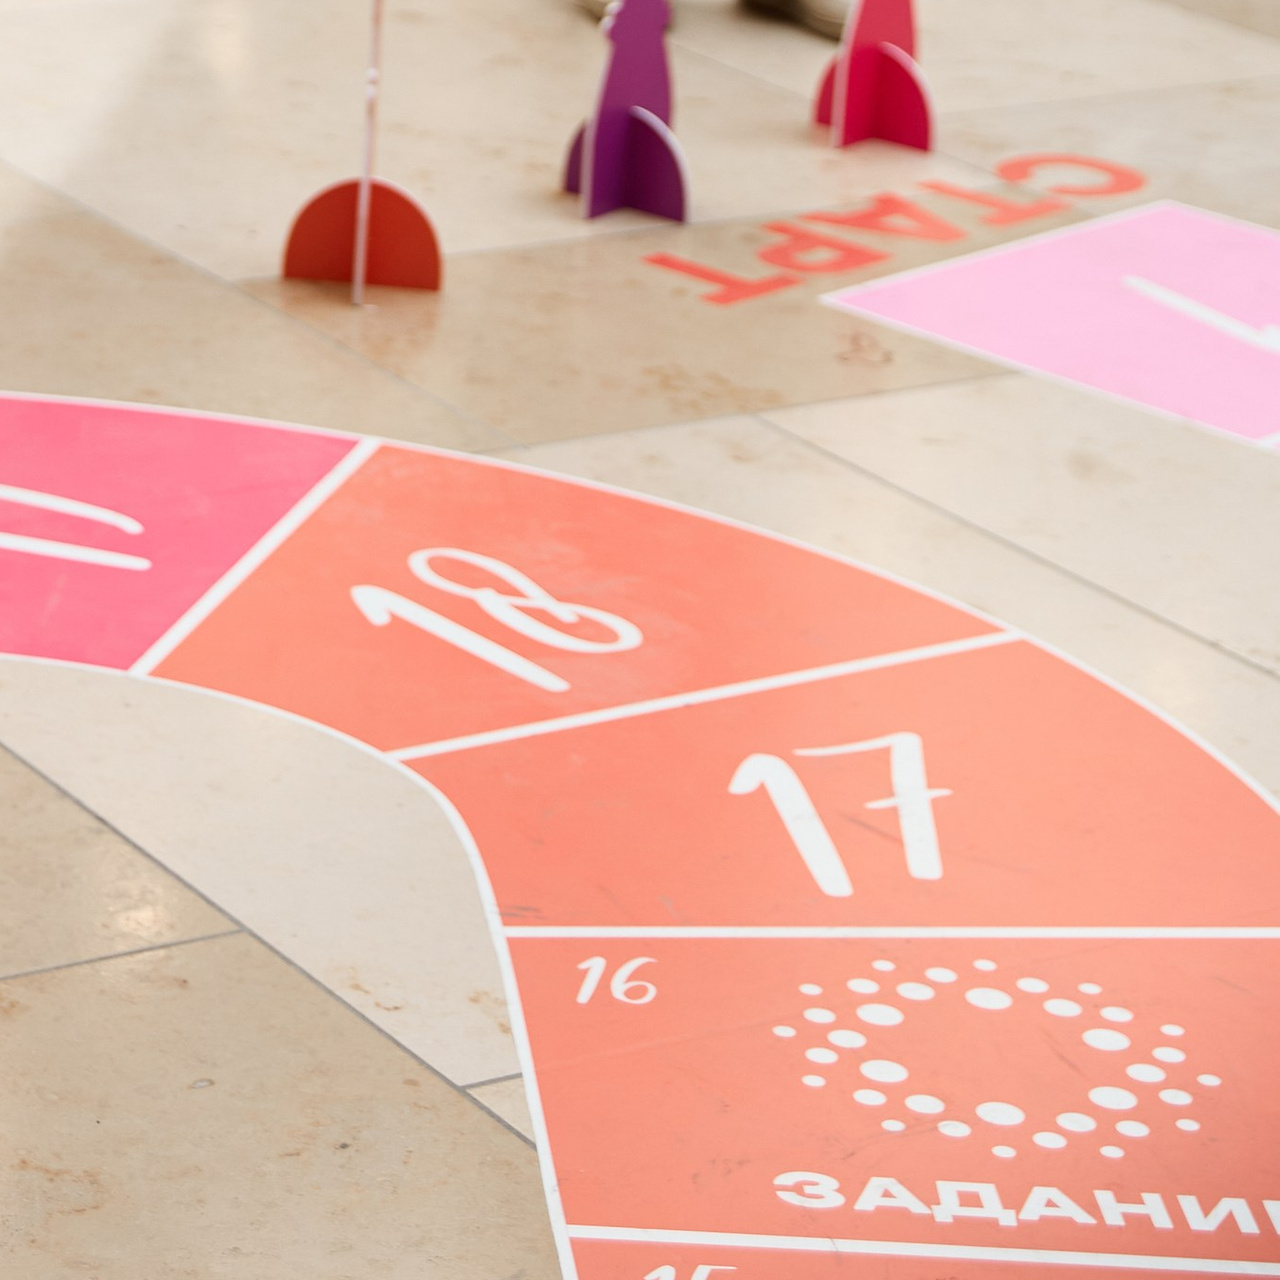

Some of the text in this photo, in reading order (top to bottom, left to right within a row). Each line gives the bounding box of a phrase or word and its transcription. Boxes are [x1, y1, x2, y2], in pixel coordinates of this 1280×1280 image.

[641, 152, 1148, 306] СТАРТ
[350, 547, 643, 692] 18
[728, 732, 953, 898] 17
[576, 956, 658, 1005] 16
